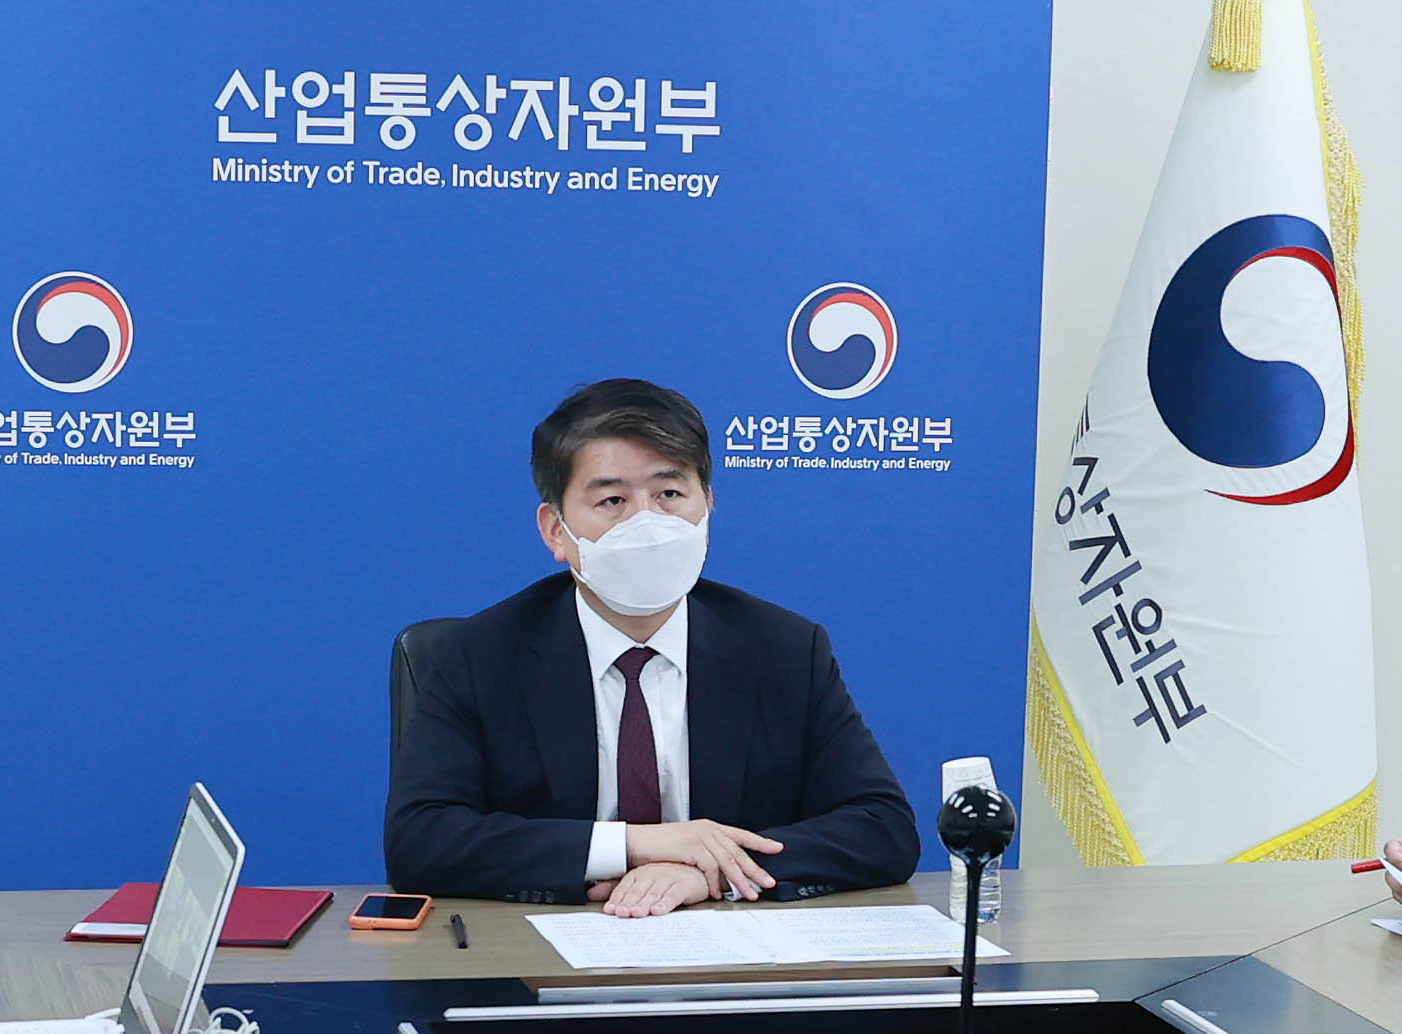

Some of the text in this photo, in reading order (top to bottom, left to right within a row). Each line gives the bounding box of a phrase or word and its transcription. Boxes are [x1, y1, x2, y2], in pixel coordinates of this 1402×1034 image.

[214, 68, 721, 154] 산업통상자원부
[212, 157, 720, 198] Ministry of Trade, Industry and Energy
[725, 416, 953, 453] 산업통상자원부
[4, 452, 18, 464] of
[64, 453, 117, 468] Industry
[120, 454, 146, 466] and
[149, 453, 195, 468] Energy
[724, 455, 773, 470] Ministry
[776, 456, 789, 468] of
[830, 457, 880, 471] Industry
[882, 458, 906, 469] and
[909, 458, 951, 472] Energy
[1055, 391, 1207, 744] 상자원부
